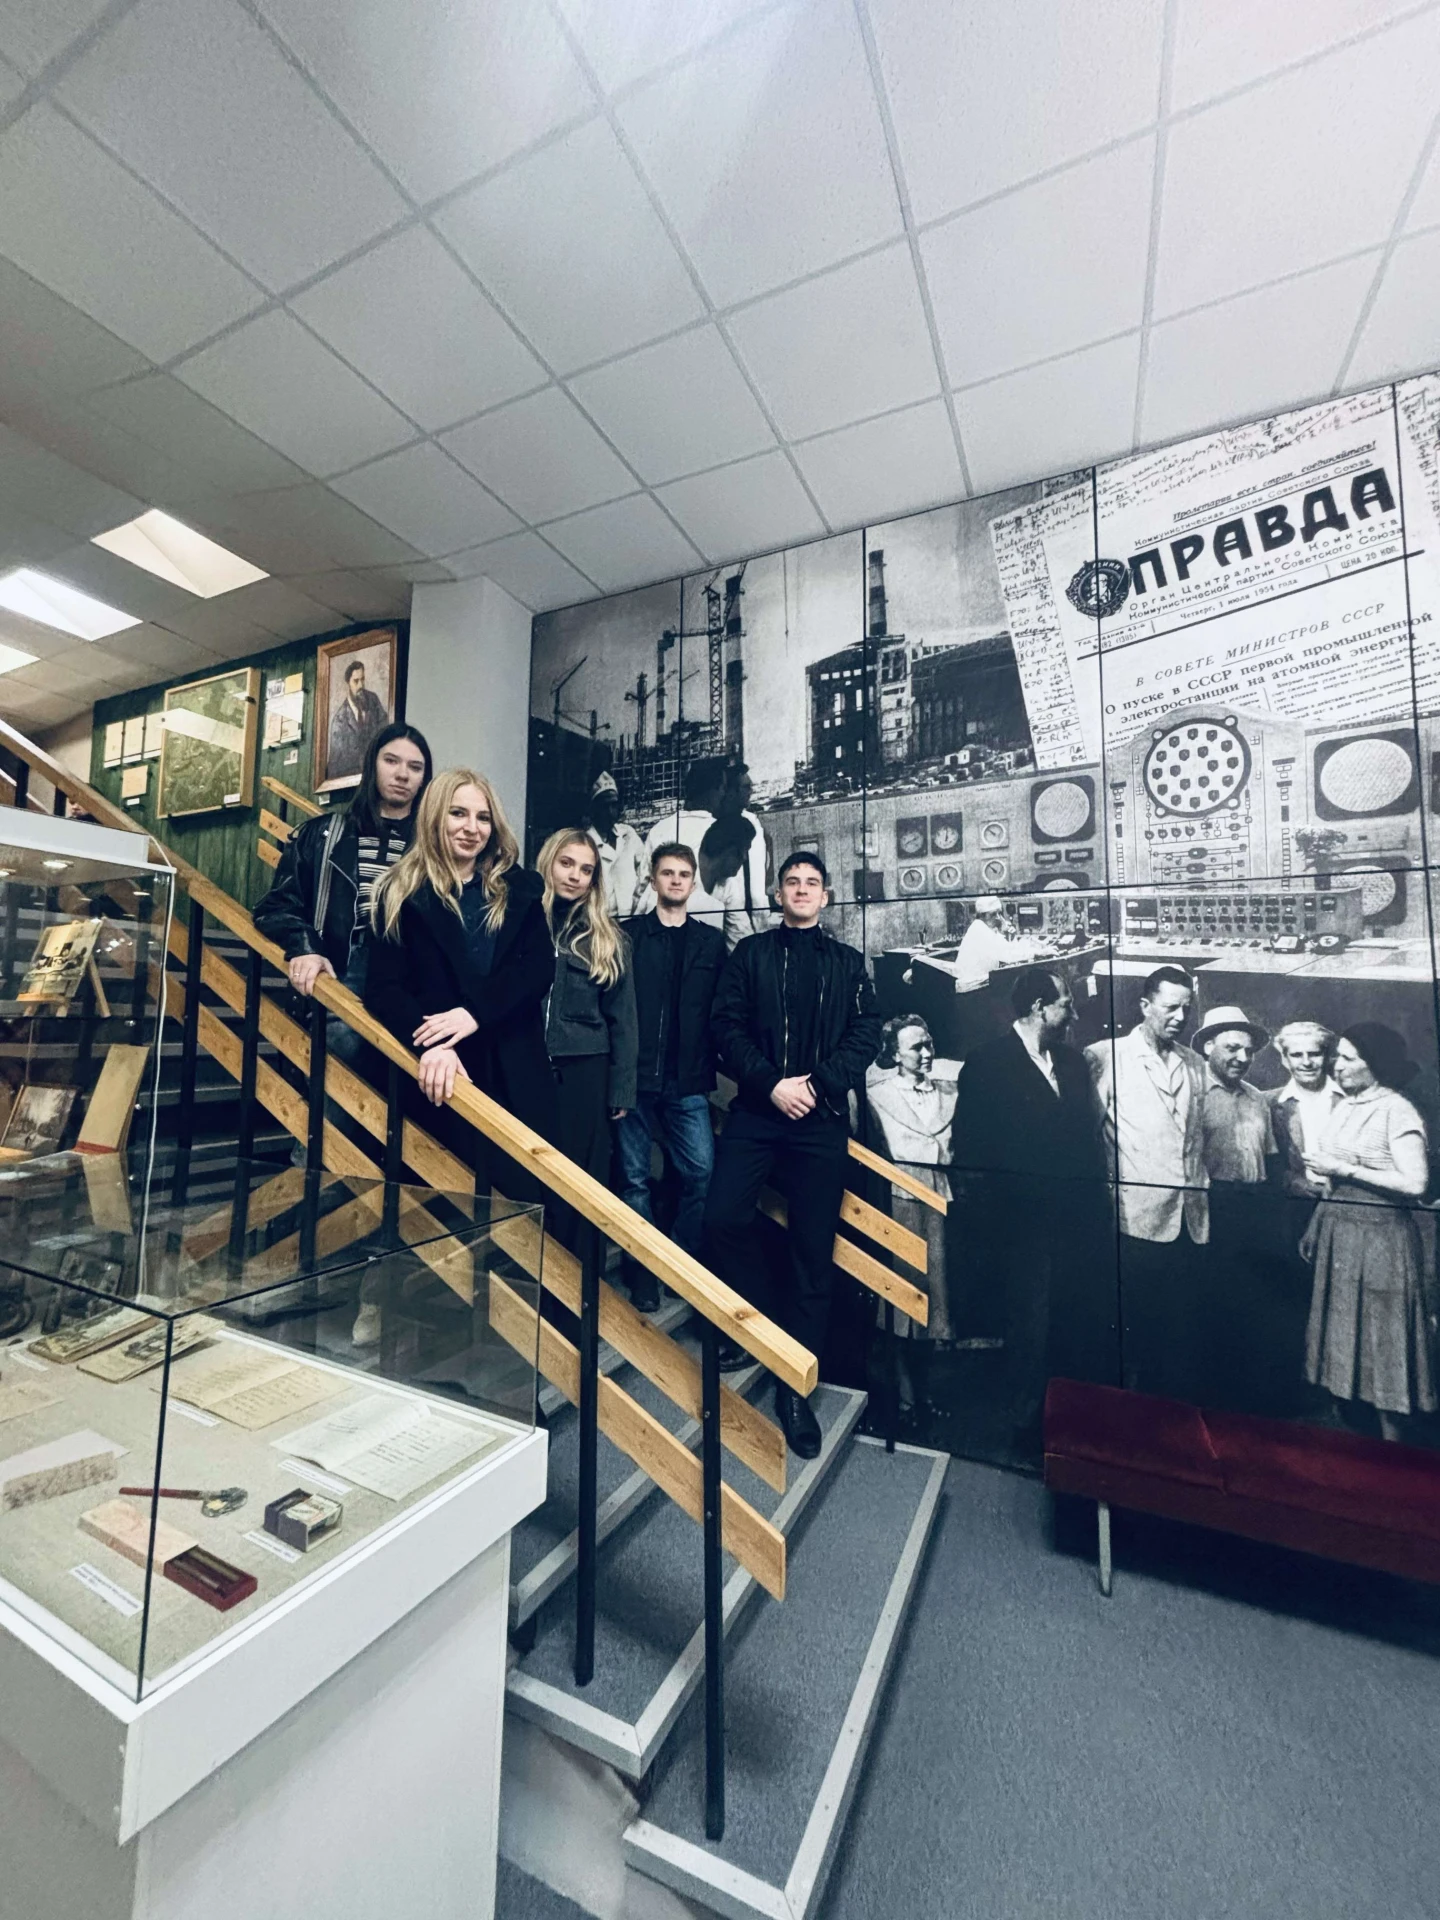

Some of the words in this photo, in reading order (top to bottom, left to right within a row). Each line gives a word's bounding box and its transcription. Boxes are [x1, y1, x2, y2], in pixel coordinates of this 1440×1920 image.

[1267, 474, 1329, 498] Советского
[1333, 458, 1371, 474] Союза
[1128, 467, 1396, 596] ПРАВДА
[1129, 583, 1230, 620] Коммунистической
[1236, 569, 1275, 589] партии
[1281, 543, 1352, 571] Советского
[1359, 528, 1403, 546] Союза
[1130, 592, 1176, 612] Орган
[1182, 550, 1301, 595] Центрального
[1308, 519, 1398, 552] Комитета
[1340, 557, 1362, 570] ЦЕНА
[1365, 551, 1378, 562] 20
[1180, 605, 1216, 620] Четверг,
[1219, 600, 1225, 609] 1
[1254, 584, 1275, 597] 1954
[1278, 577, 1299, 589] года
[1104, 703, 1117, 716] О
[1122, 691, 1165, 713] пуске
[1172, 686, 1182, 696] в
[1187, 669, 1233, 691] СССР
[1240, 653, 1295, 677] первой
[1302, 612, 1433, 660] промышленной
[1120, 683, 1240, 723] электростанции
[1247, 675, 1266, 688] на
[1271, 653, 1342, 681] атомной
[1135, 676, 1145, 688] В
[1154, 655, 1216, 681] СОВЕТЕ
[1224, 620, 1330, 661] МИНИСТРОВ
[1341, 602, 1385, 624] СССР
